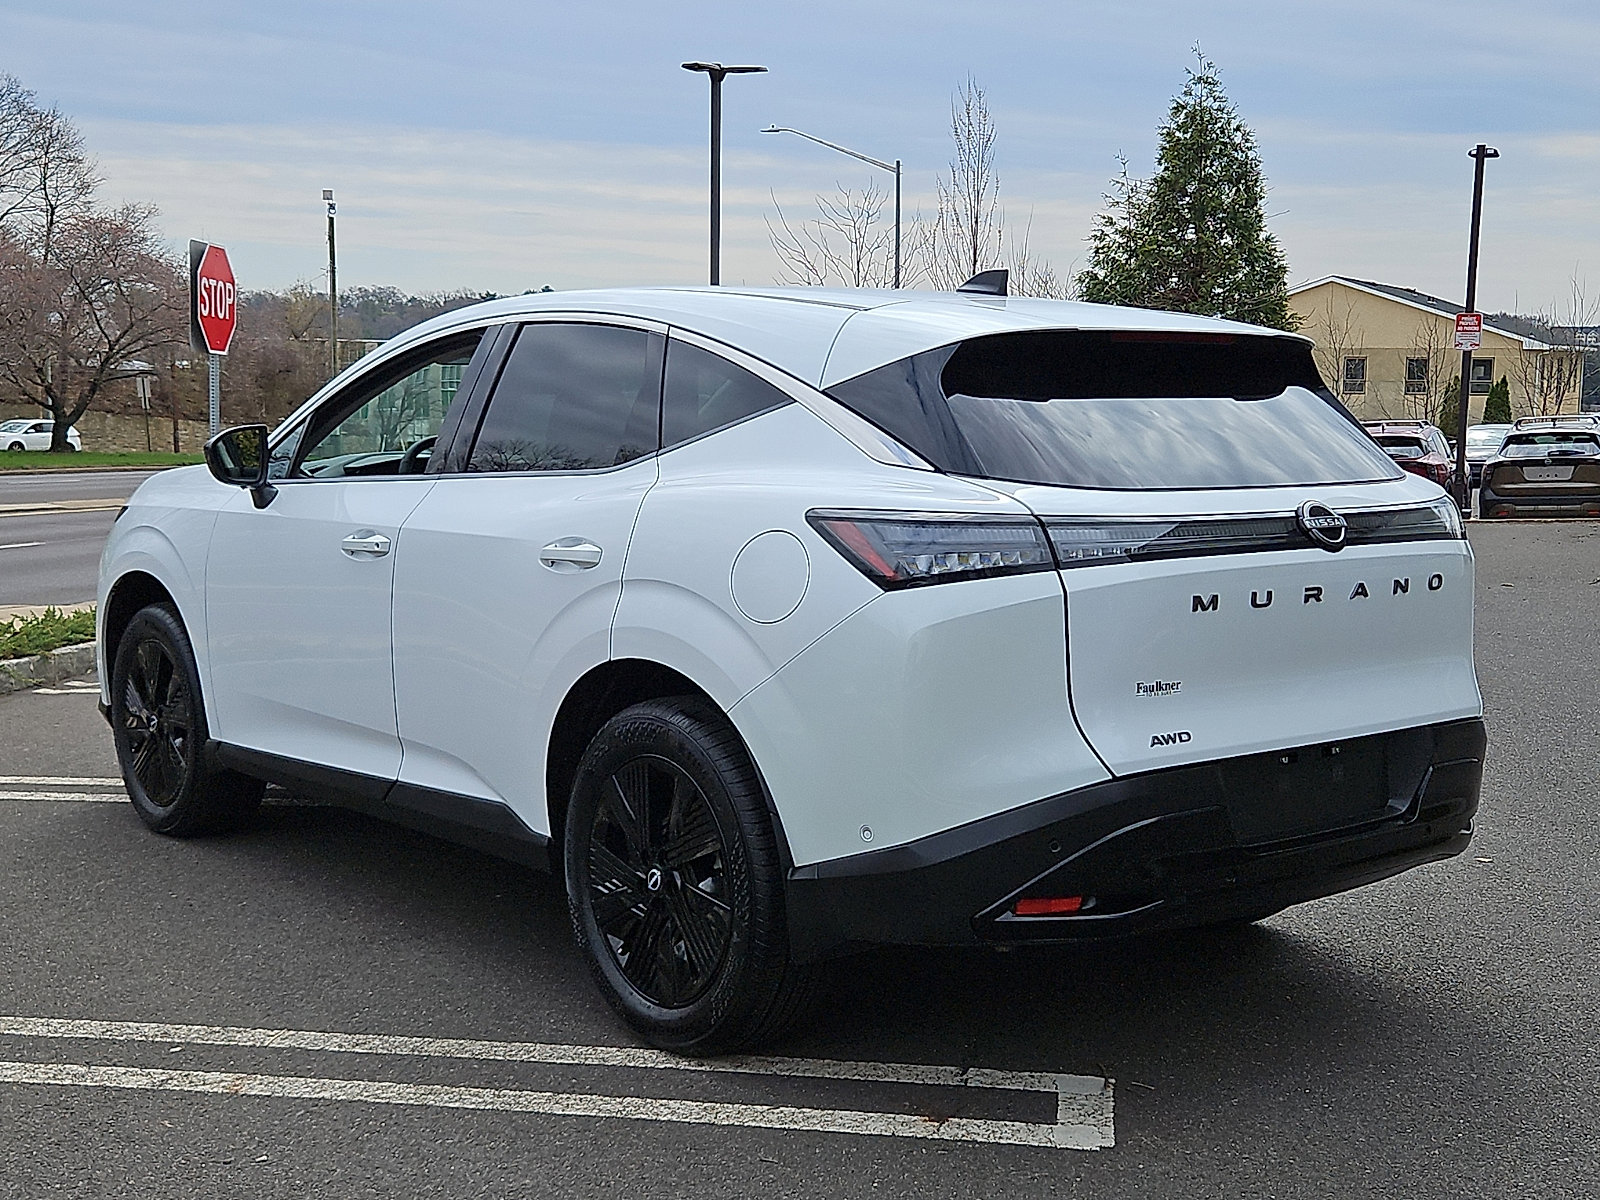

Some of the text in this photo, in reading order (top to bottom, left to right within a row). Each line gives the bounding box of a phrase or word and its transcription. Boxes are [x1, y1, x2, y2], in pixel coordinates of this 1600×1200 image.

[200, 277, 234, 320] STOP
[1191, 573, 1443, 612] MURANO
[1136, 681, 1181, 694] Faulkner
[1150, 731, 1191, 747] AWD
